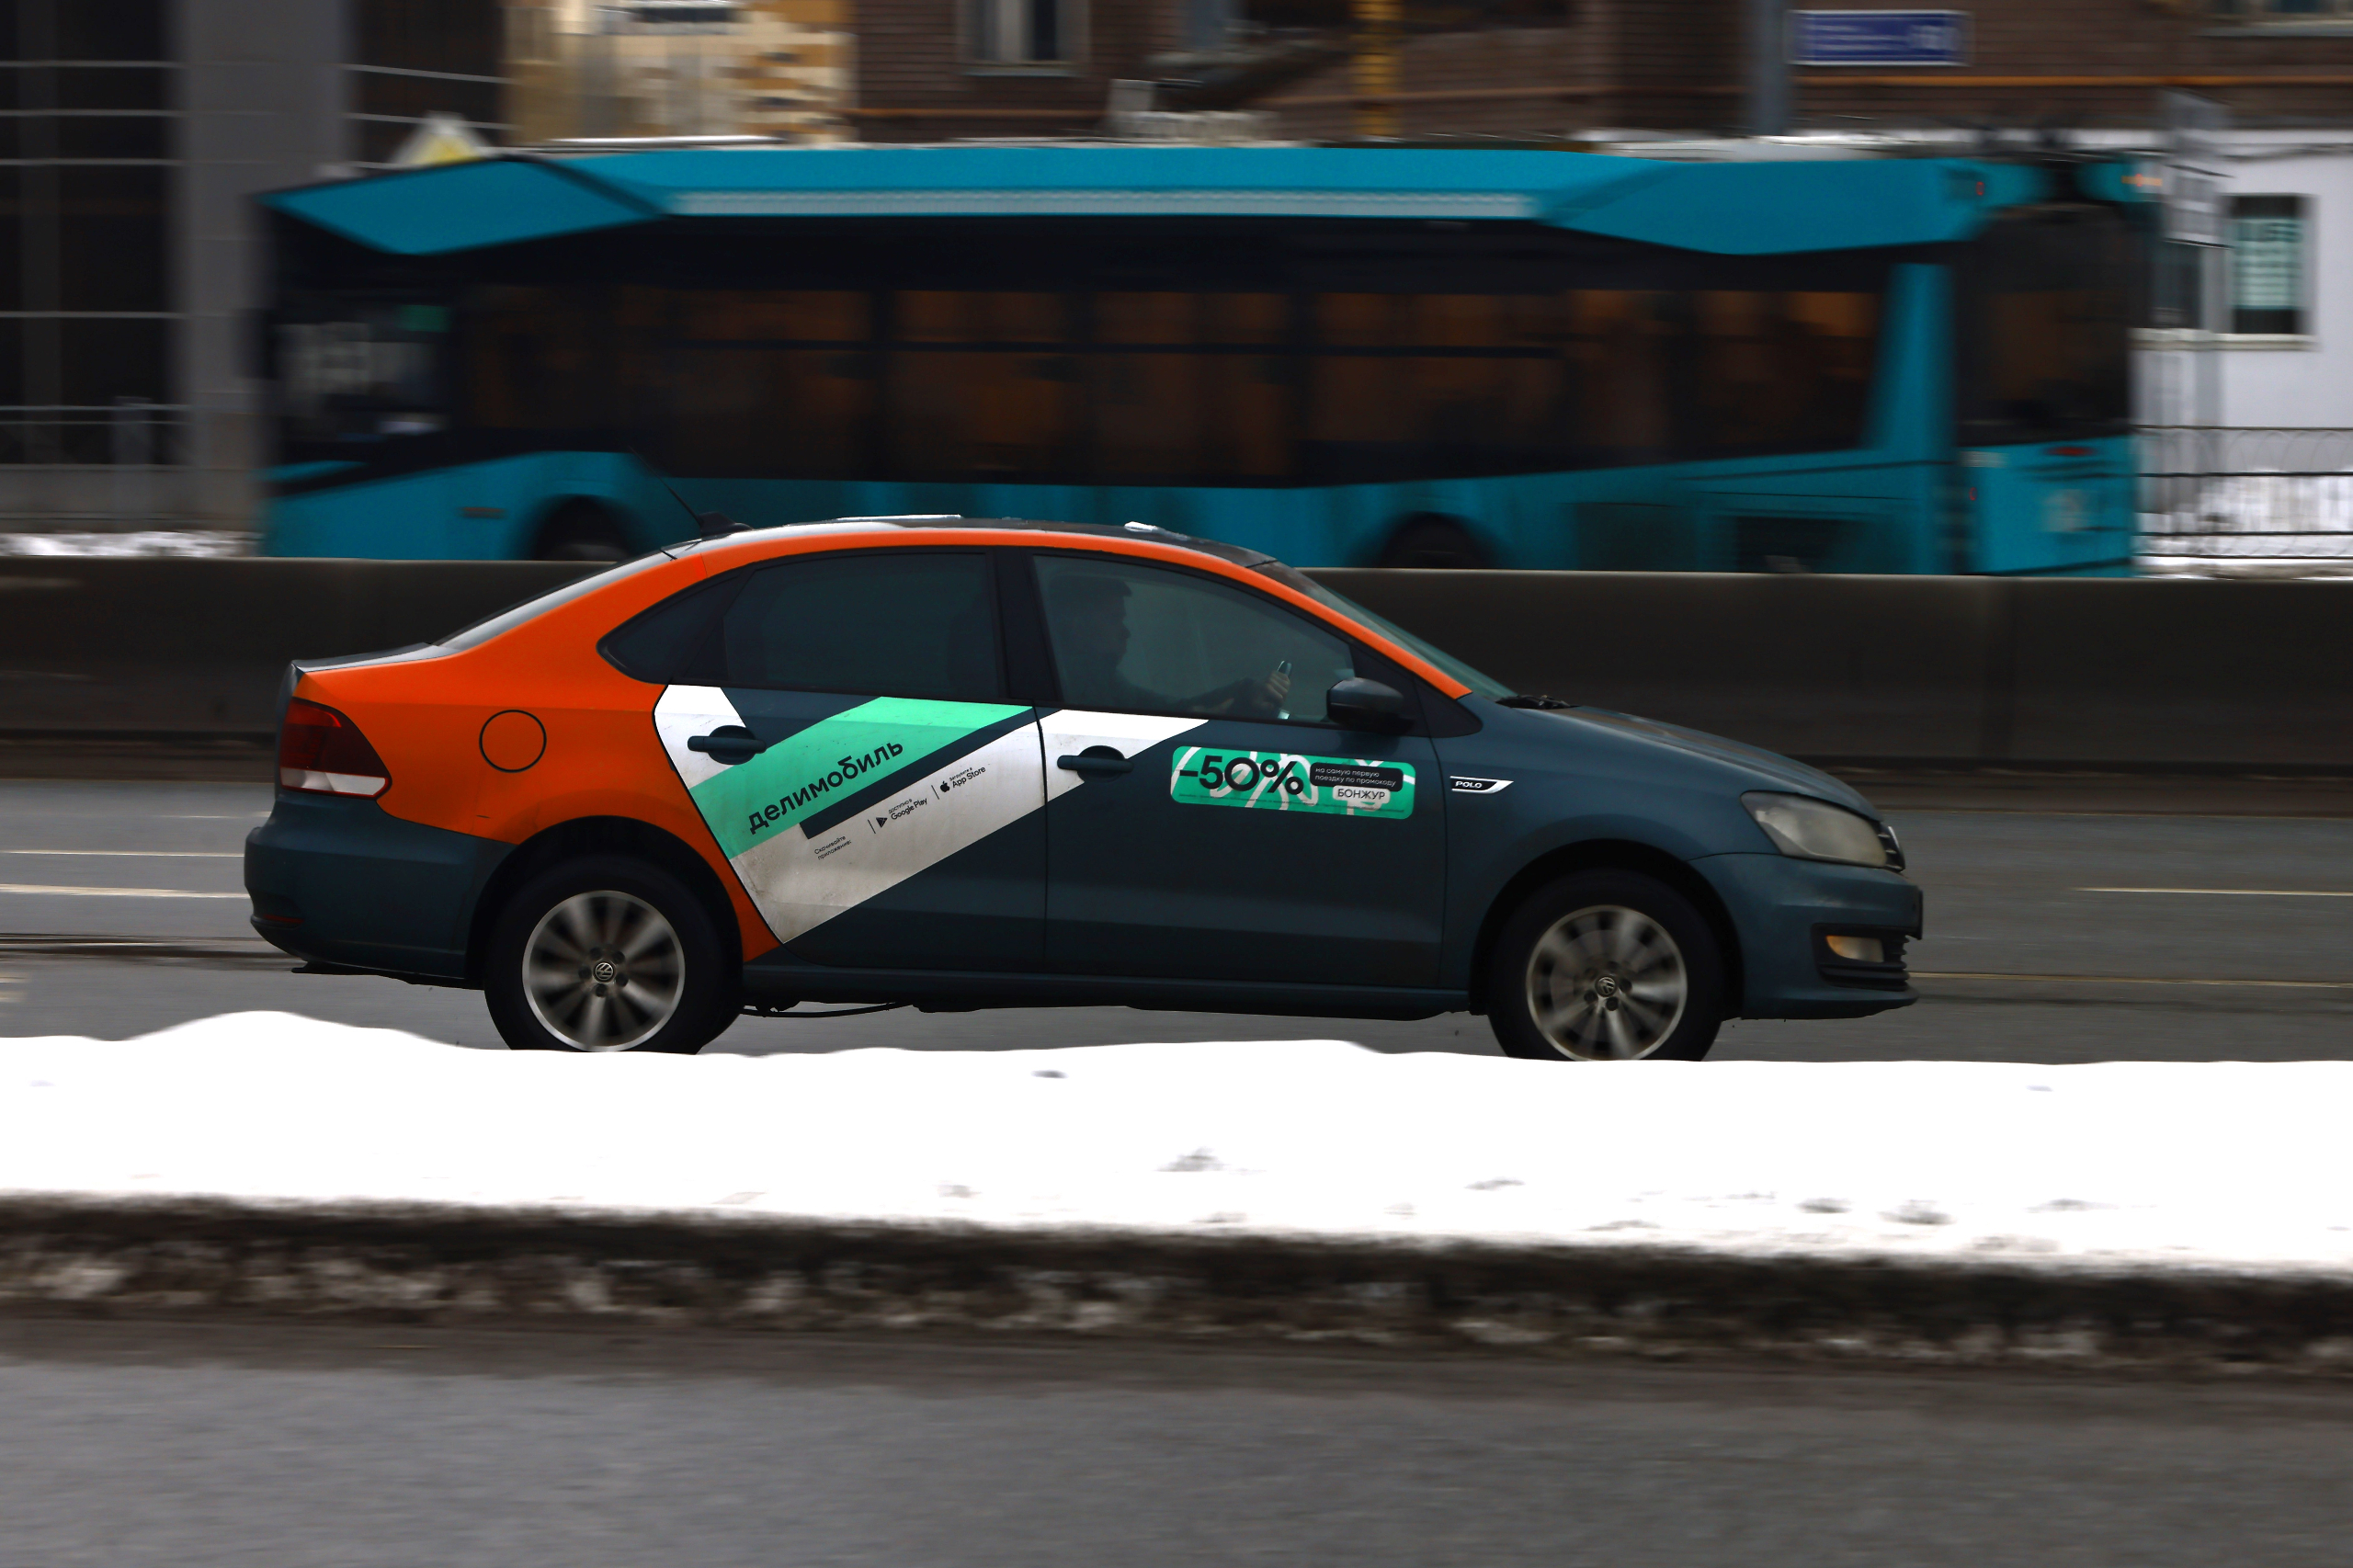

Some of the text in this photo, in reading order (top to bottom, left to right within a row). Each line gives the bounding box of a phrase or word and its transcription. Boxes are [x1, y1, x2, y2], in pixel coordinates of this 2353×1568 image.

[952, 767, 986, 788] App Store
[1179, 755, 1304, 796] -50%
[1314, 775, 1345, 784] поездку
[1356, 778, 1396, 787] промокоду
[1326, 768, 1351, 777] самую
[1352, 769, 1380, 778] первую
[748, 742, 904, 835] делимобиль
[1337, 788, 1386, 801] БОНЖУР
[1455, 780, 1483, 790] POLO
[891, 798, 928, 820] Google Play
[814, 835, 847, 855] Скачивайте
